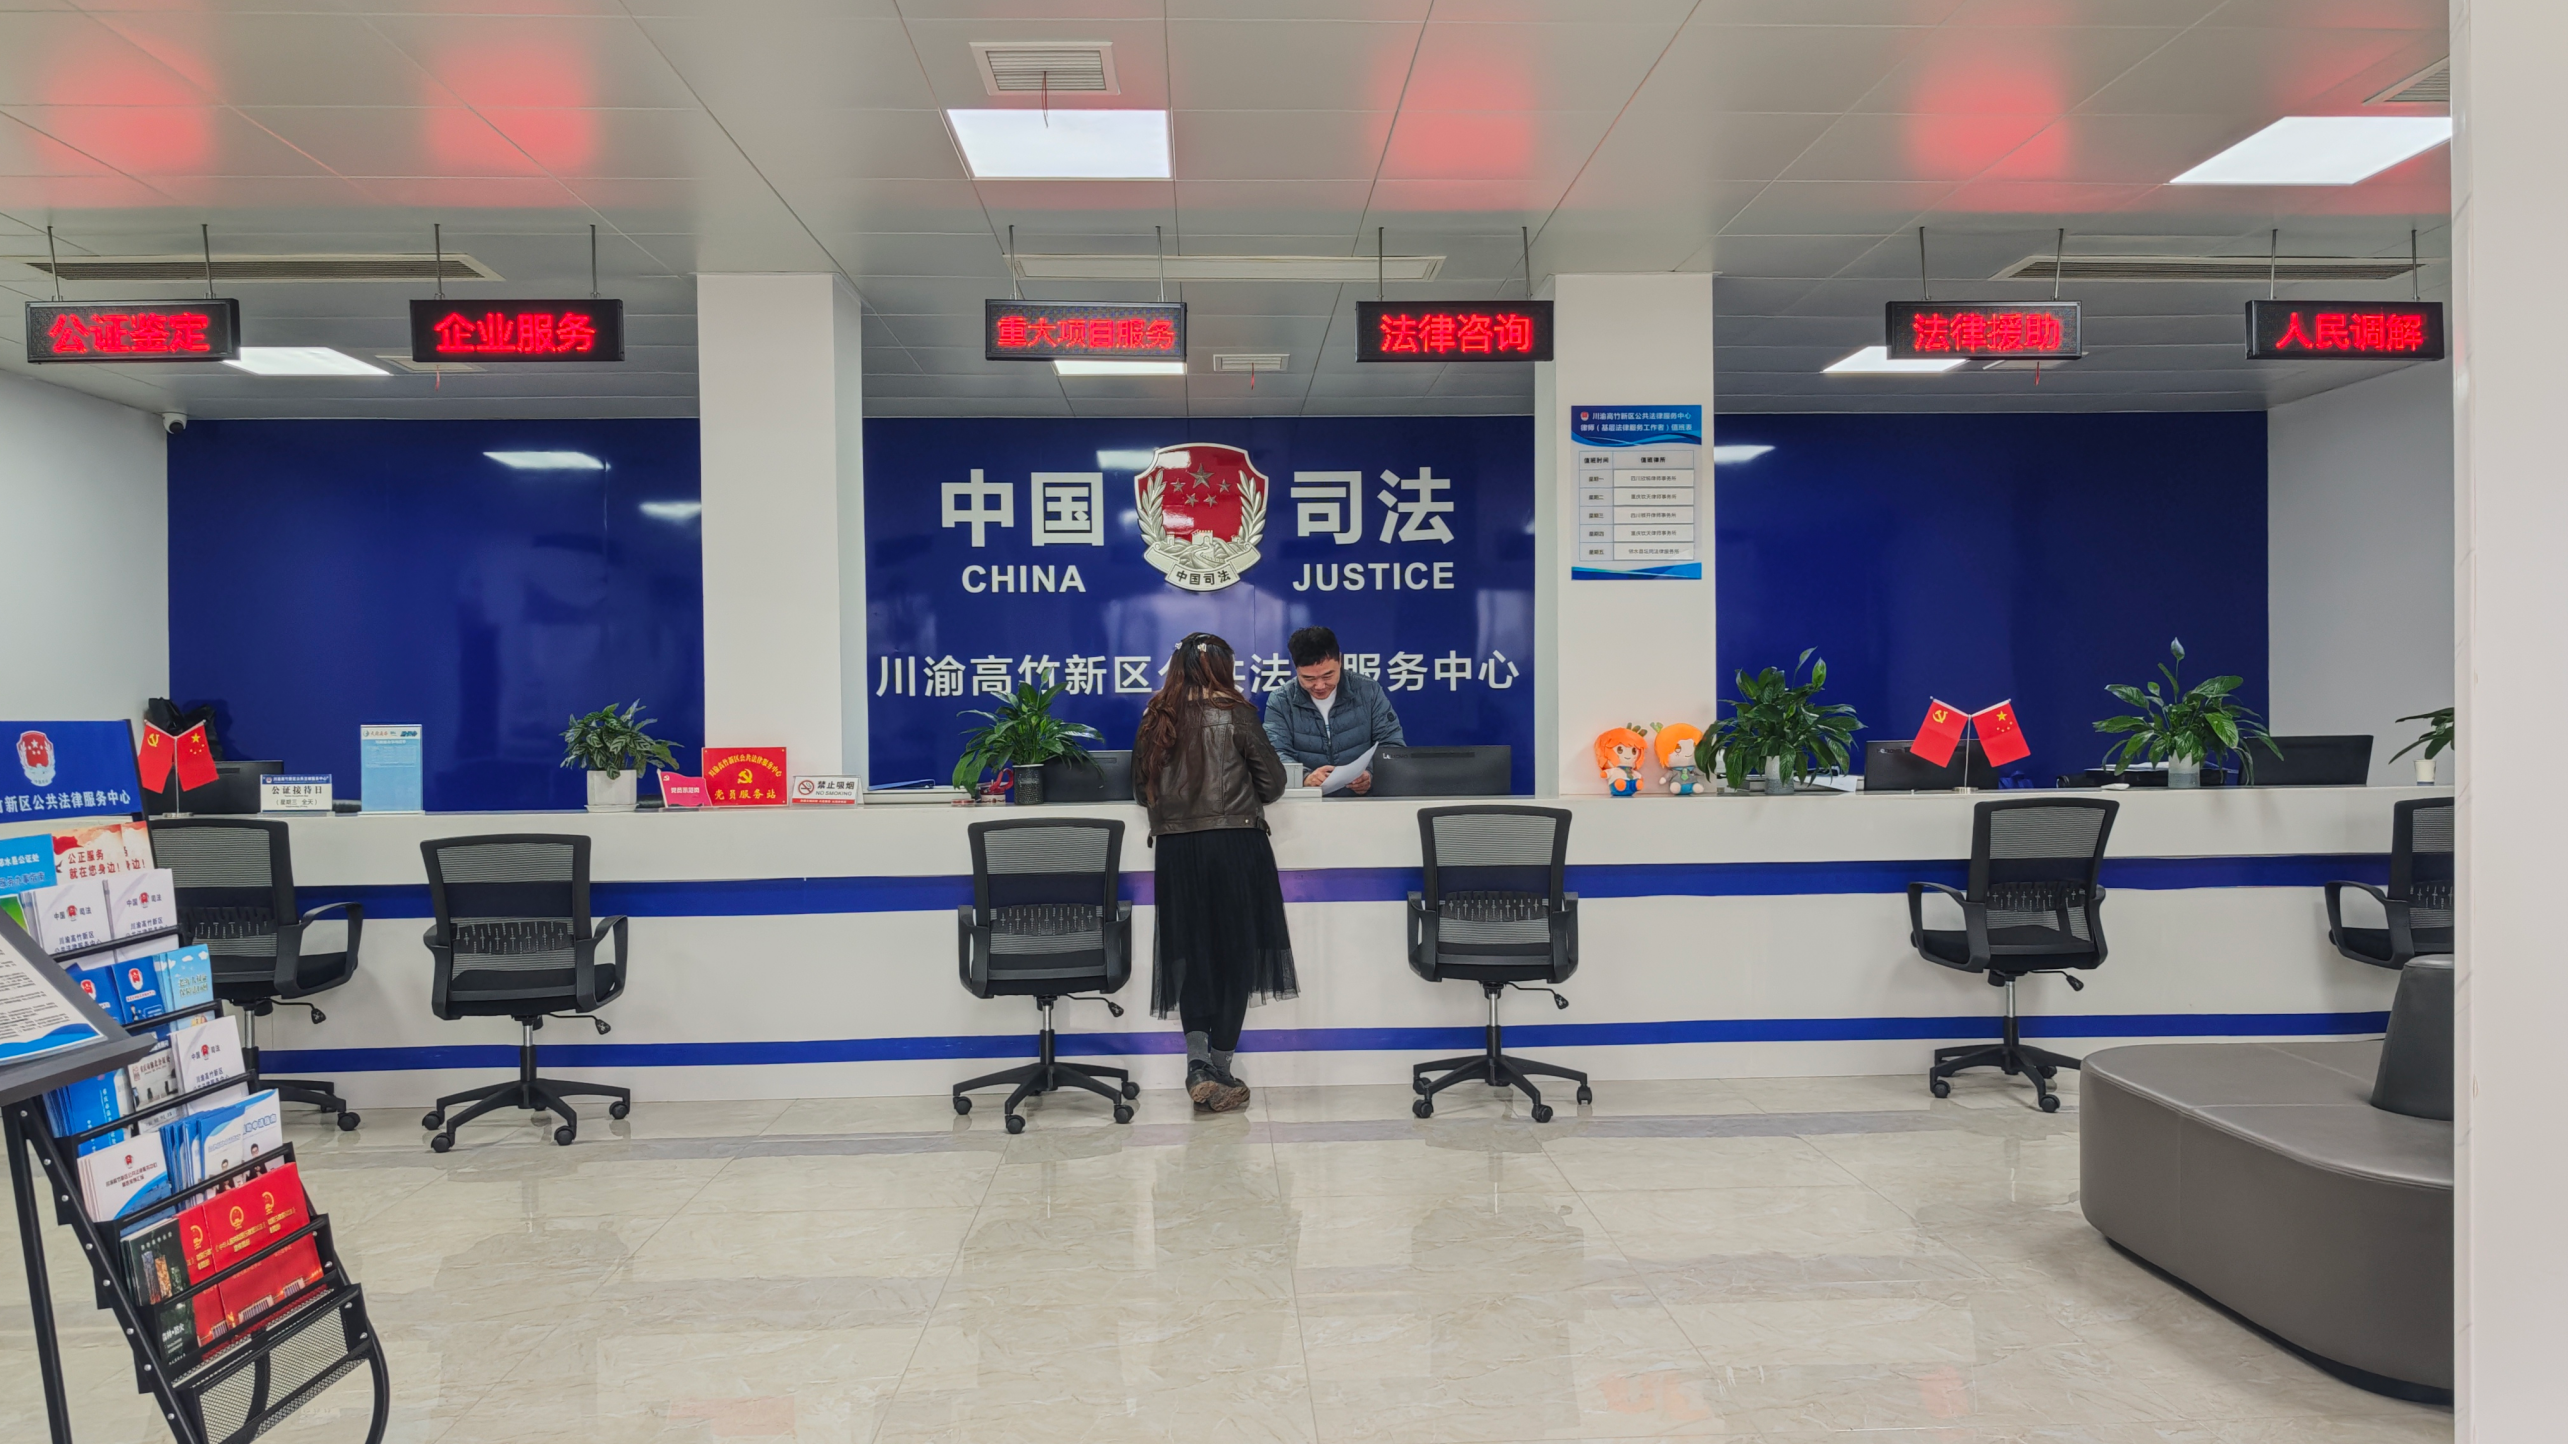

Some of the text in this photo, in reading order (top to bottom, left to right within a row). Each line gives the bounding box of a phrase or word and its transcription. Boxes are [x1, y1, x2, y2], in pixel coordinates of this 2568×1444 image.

[48, 312, 210, 354] 公证鉴定
[434, 311, 597, 354] 企业服务
[997, 315, 1175, 349] 重大项目服务
[1380, 313, 1531, 354] 法律咨询
[1913, 312, 2061, 353] 法律援助
[2275, 311, 2425, 352] 人民调解
[1592, 412, 1692, 420] 川渝高竹新区公共法律服务中心
[941, 466, 1455, 548] 中国 司法
[961, 561, 1455, 593] CHINA JUSTICE
[1176, 570, 1231, 585] 中国司法
[876, 649, 1520, 697] 川渝高竹新区法服务中心
[0, 789, 131, 814] 新区公共法律服务中心
[272, 785, 323, 795] 公证接待日
[715, 788, 776, 800] 党员服务站
[817, 781, 855, 790] 禁止吸烟
[68, 849, 104, 865] 公正服务
[69, 862, 121, 880] 就在您身边！
